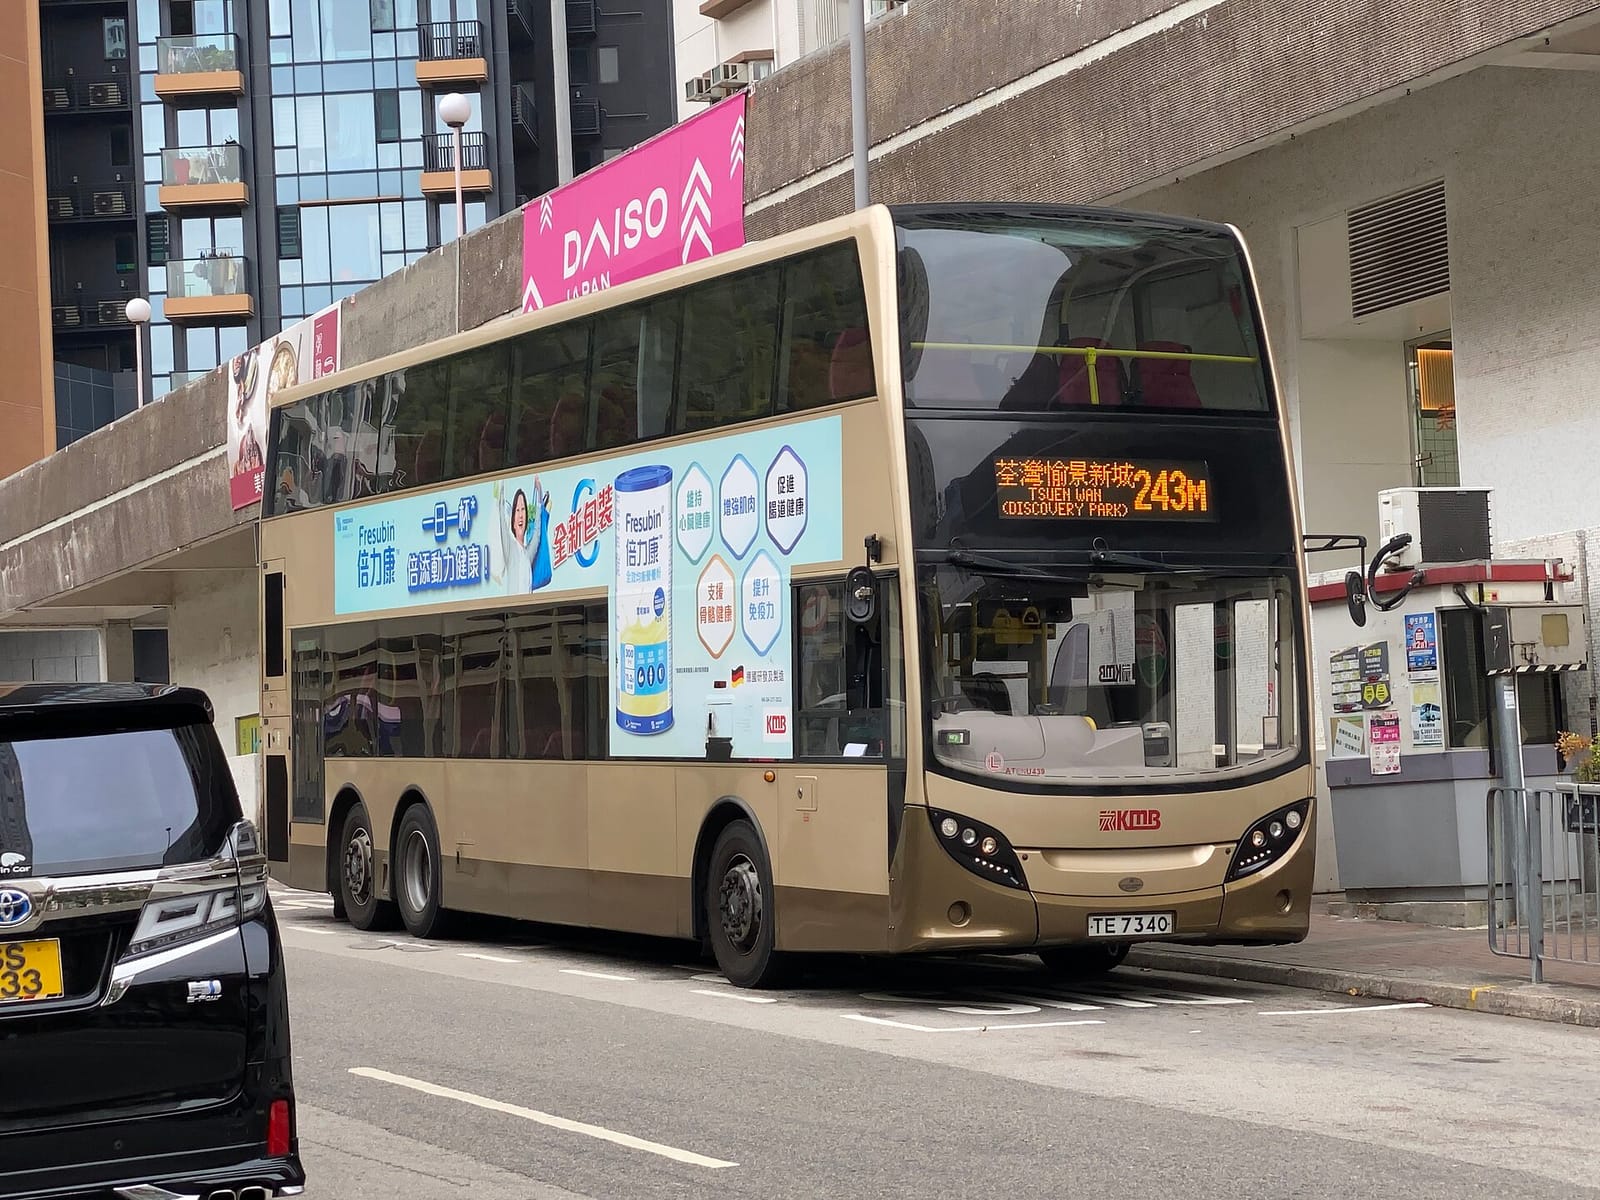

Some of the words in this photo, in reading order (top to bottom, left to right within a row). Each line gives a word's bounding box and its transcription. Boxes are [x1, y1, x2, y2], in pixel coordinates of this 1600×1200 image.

[563, 187, 669, 280] DAISO
[777, 474, 795, 495] 促進
[995, 458, 1136, 489] 荃灣愉景新城
[1134, 469, 1208, 512] 243M
[1028, 487, 1071, 502] TSUEN
[1076, 488, 1102, 503] WAN
[723, 495, 756, 517] 增強肌肉
[768, 497, 804, 520] 腸道健康
[1002, 500, 1082, 516] (DISCOVERY
[1089, 502, 1129, 518] PARK)
[553, 483, 614, 570] 全新包裝
[625, 509, 662, 533] Fresubin
[358, 520, 395, 546] Fresubin
[625, 536, 660, 567] 倍力康
[357, 545, 396, 589] 倍力康
[707, 582, 724, 601] 支援
[752, 577, 770, 597] 提升
[699, 604, 733, 625] 骨骼健康
[749, 601, 775, 621] 免疫力
[766, 714, 787, 734] KMB
[1116, 809, 1161, 831] KMB
[1093, 917, 1116, 934] TE
[1121, 916, 1168, 933] 7340
[0, 944, 26, 970] S
